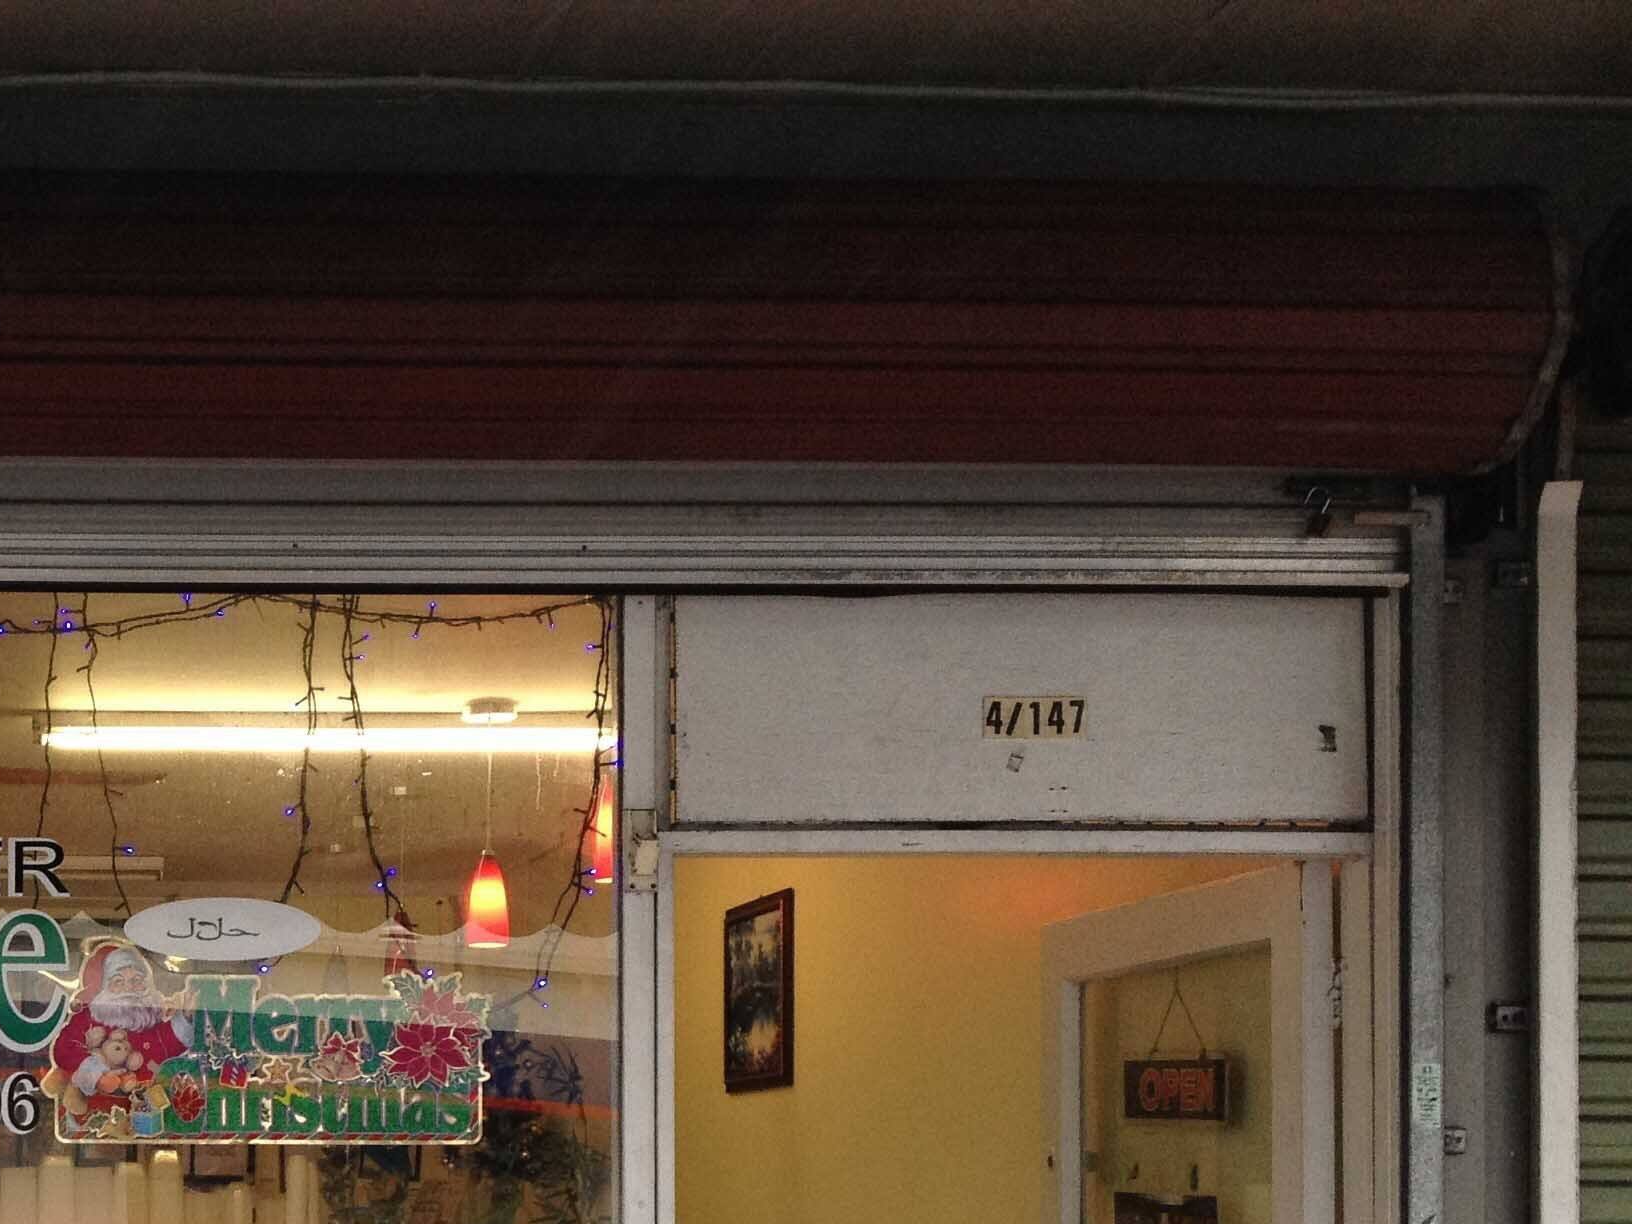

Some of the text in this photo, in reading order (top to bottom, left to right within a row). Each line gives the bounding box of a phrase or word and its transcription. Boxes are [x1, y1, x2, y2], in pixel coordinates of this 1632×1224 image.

[986, 700, 1085, 736] 4/147
[166, 917, 260, 941] حلال
[185, 974, 406, 1077] Merry
[1139, 1067, 1216, 1112] OPEN
